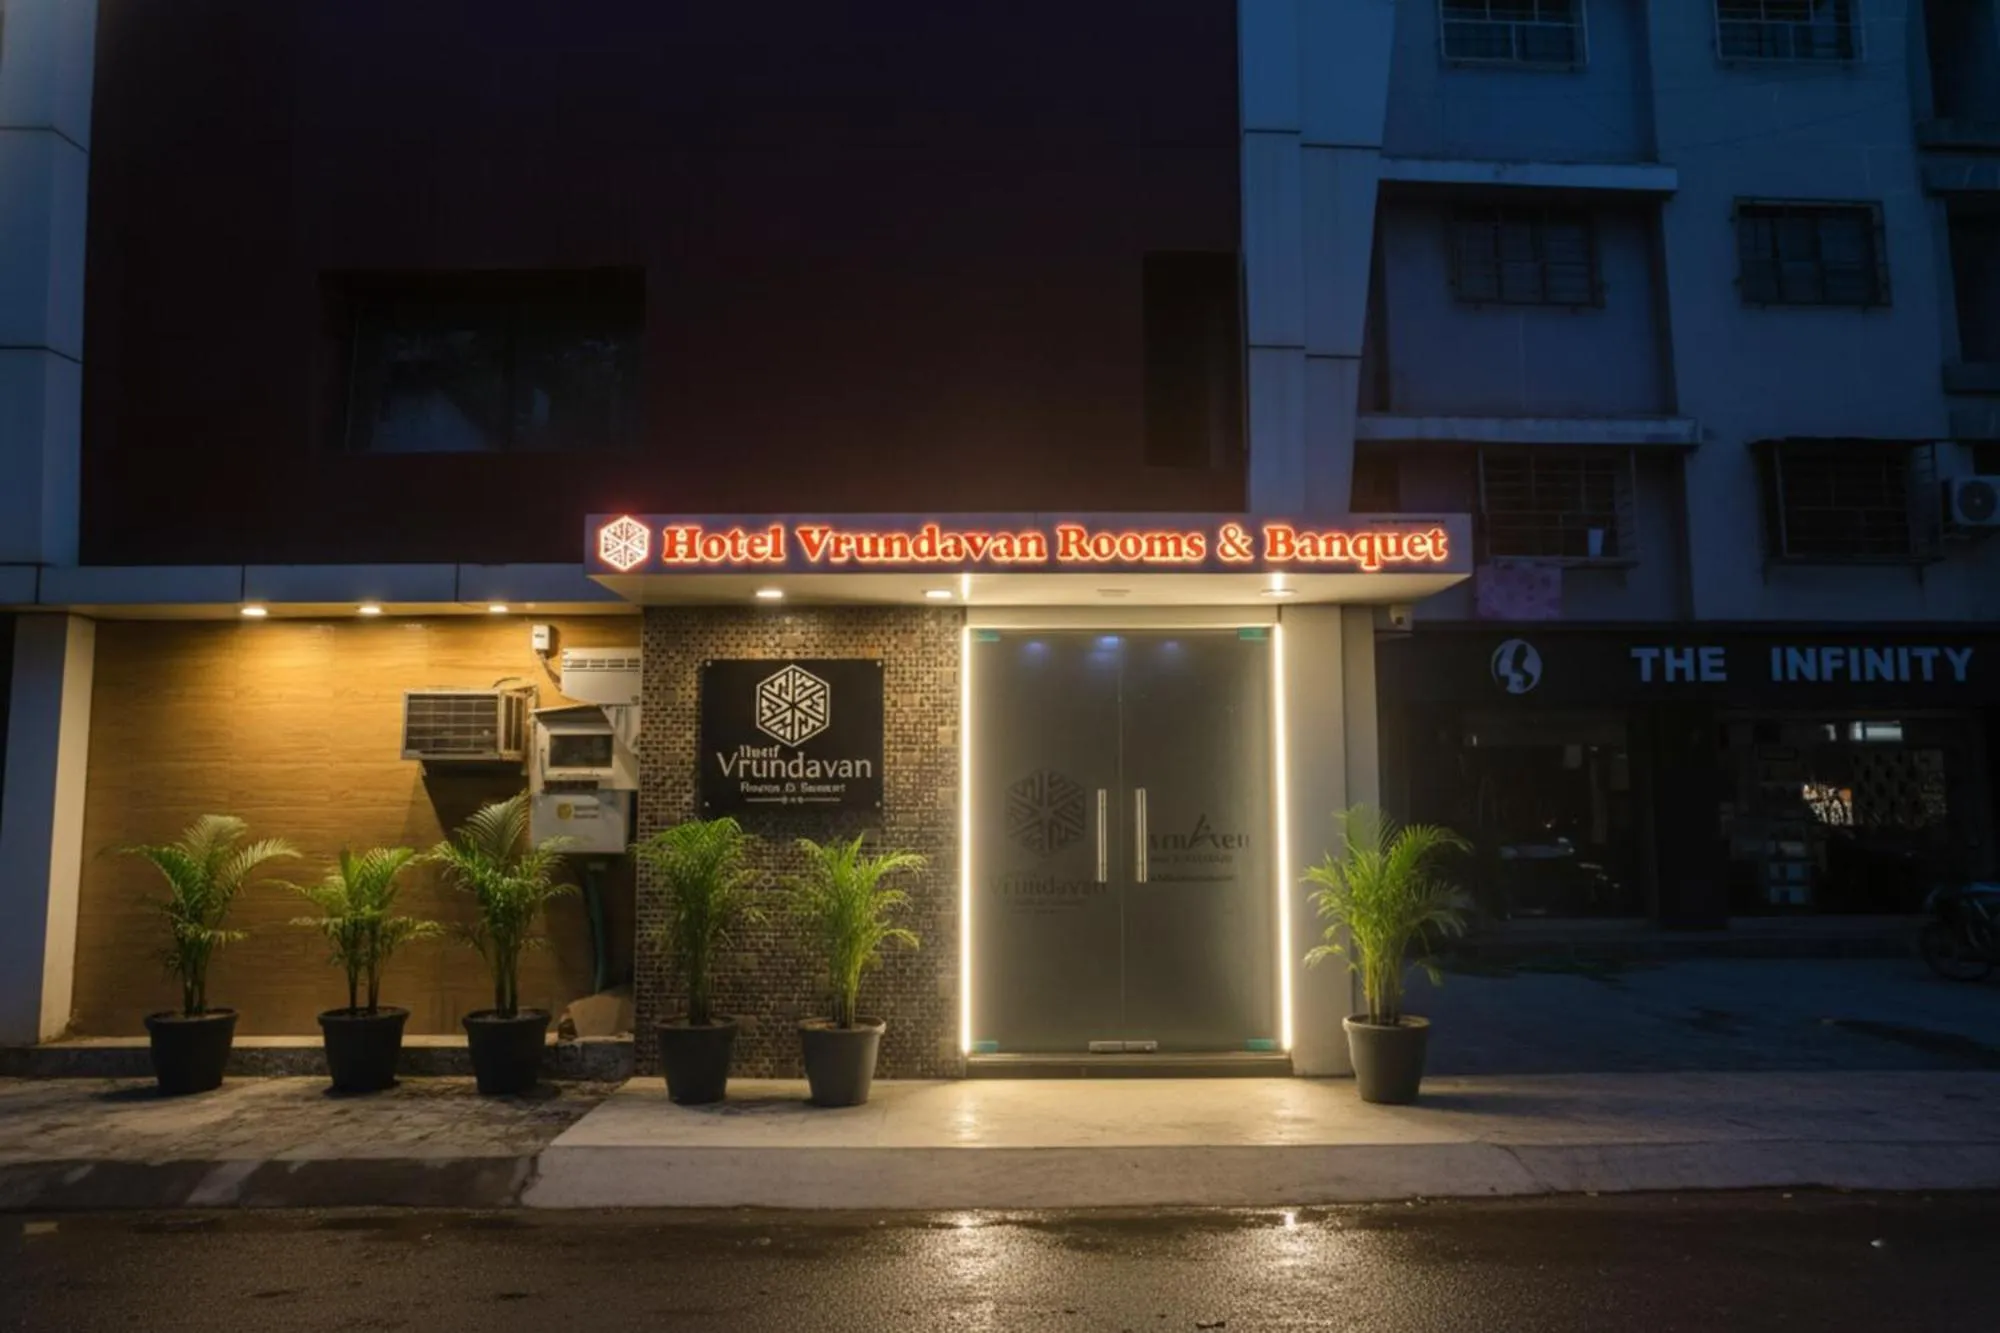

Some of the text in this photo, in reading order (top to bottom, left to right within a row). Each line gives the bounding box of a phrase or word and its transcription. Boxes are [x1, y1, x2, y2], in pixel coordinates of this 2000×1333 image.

[662, 523, 1450, 571] Hotel Vrundavan Rooms & Banquet
[1631, 647, 1974, 683] THE INFINITY
[716, 751, 873, 778] Vrundavan
